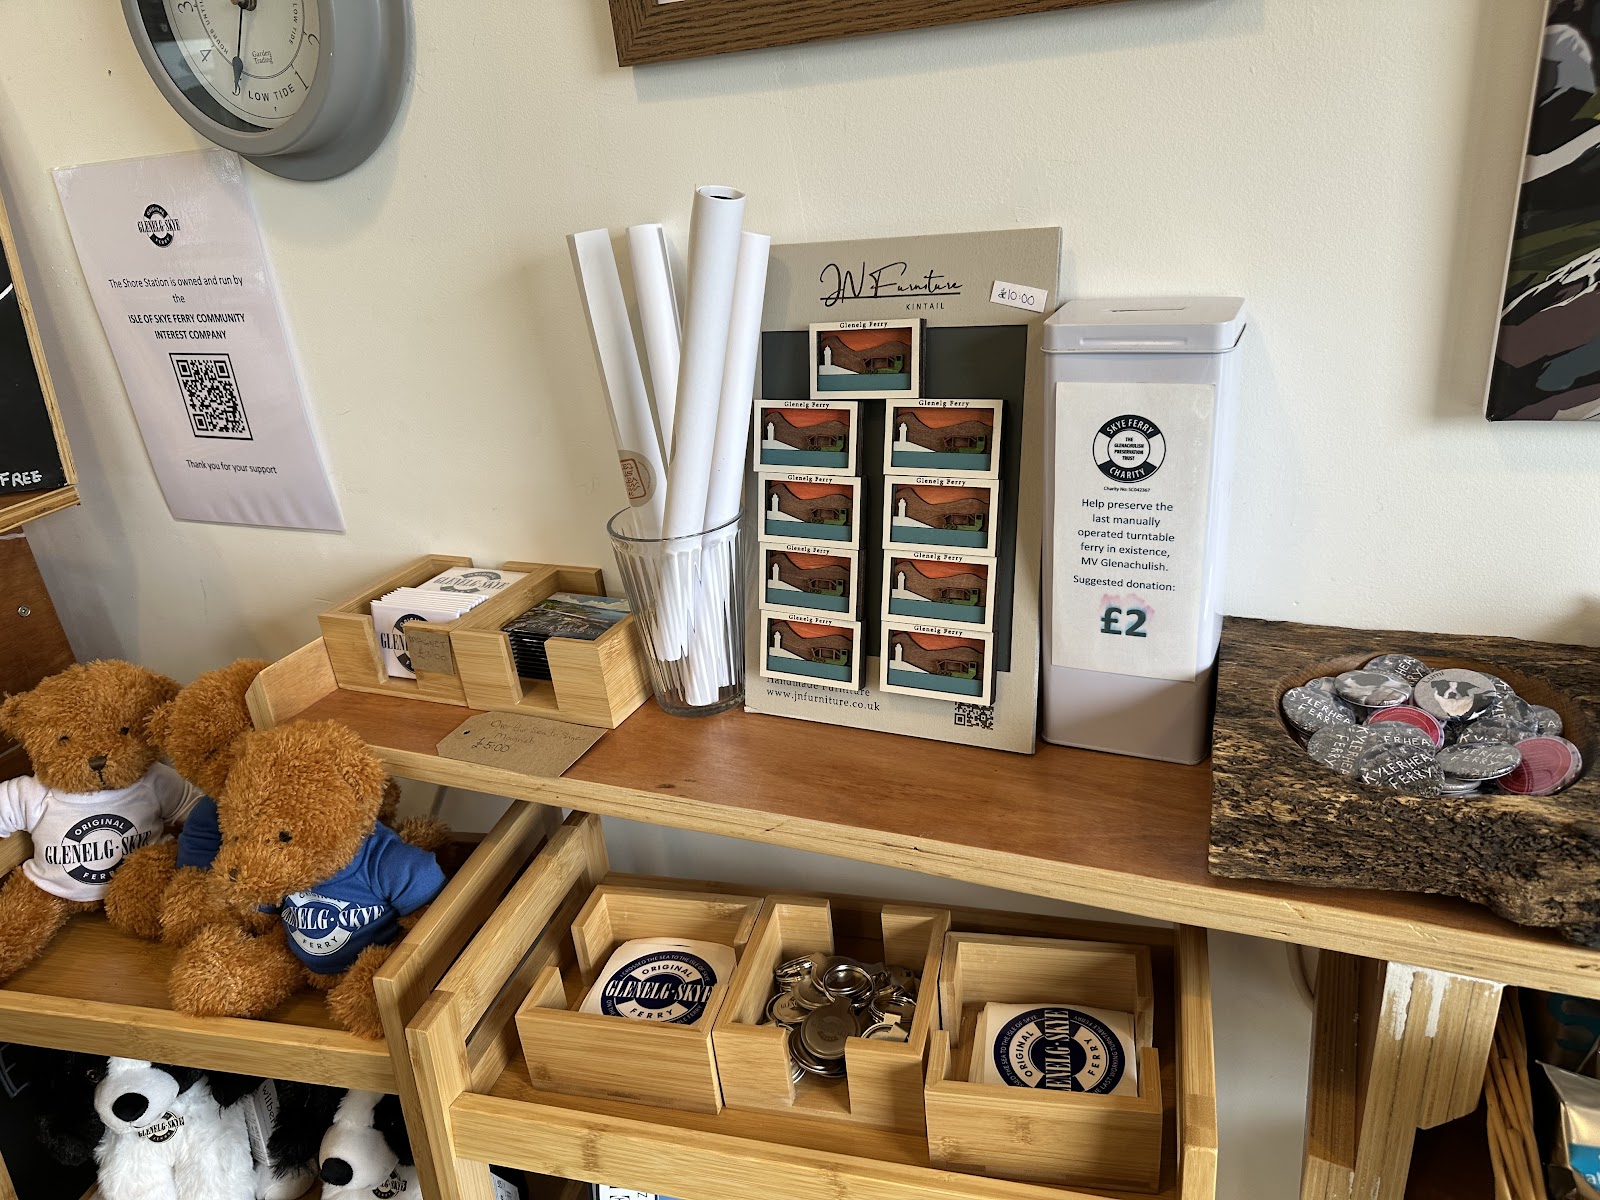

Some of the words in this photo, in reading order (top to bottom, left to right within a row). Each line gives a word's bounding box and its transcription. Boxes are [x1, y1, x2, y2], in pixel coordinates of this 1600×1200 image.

[248, 90, 270, 102] LOW
[273, 83, 295, 100] TIDE
[108, 280, 122, 288] The
[122, 278, 143, 288] Shore
[144, 278, 169, 287] Station
[169, 277, 176, 286] is
[178, 276, 202, 286] owned
[204, 275, 217, 286] and
[219, 277, 231, 285] run
[232, 275, 243, 286] by
[868, 262, 963, 298] Furniture
[172, 294, 185, 303] the
[128, 314, 143, 323] ISLE
[144, 314, 154, 323] OF
[155, 314, 172, 323] SKYE
[173, 314, 195, 323] FERRY
[196, 313, 245, 322] COMMUNITY
[154, 330, 188, 339] INTEREST
[189, 330, 227, 339] COMPANY
[918, 400, 945, 408] Glenelg
[948, 400, 970, 408] Ferry
[1106, 420, 1126, 434] SKYE
[1128, 418, 1154, 434] FERRY
[186, 459, 207, 469] Thank
[208, 462, 220, 470] you
[220, 462, 231, 470] for
[232, 464, 248, 472] your
[250, 466, 277, 474] support
[1110, 467, 1145, 479] CHARITY
[0, 470, 42, 486] FREE
[788, 474, 814, 482] Glenelg
[916, 477, 944, 486] Glenelg
[946, 478, 966, 486] Ferry
[1082, 498, 1104, 510] Help
[1108, 502, 1152, 512] preserve
[1156, 502, 1174, 512] the
[1092, 514, 1110, 524] last
[1113, 516, 1160, 528] manually
[1078, 529, 1123, 540] operated
[1126, 532, 1175, 542] turntable
[786, 545, 812, 553] Glenelg
[914, 552, 942, 560] Glenelg
[1080, 542, 1104, 554] ferry
[1107, 544, 1116, 553] in
[1119, 547, 1170, 558] existence,
[1081, 557, 1098, 566] MV
[1100, 558, 1168, 572] Glenachulish.
[1073, 575, 1123, 587] Suggested
[1126, 580, 1176, 592] donation:
[788, 614, 814, 623] Glenelg
[815, 618, 832, 626] Ferry
[1100, 606, 1147, 638] £2
[914, 625, 942, 634] Glenelg
[944, 628, 963, 636] Ferry
[766, 688, 880, 711] www.jnfurniture.co.uk
[1362, 753, 1432, 784] KYLERHEA
[74, 818, 124, 836] ORIGINAL
[302, 936, 338, 949] FERRY
[642, 964, 693, 978] ORIGINAL
[630, 1008, 673, 1018] FERRY
[1016, 1031, 1034, 1077] ORIGINAL
[1084, 1038, 1100, 1076] FERRY
